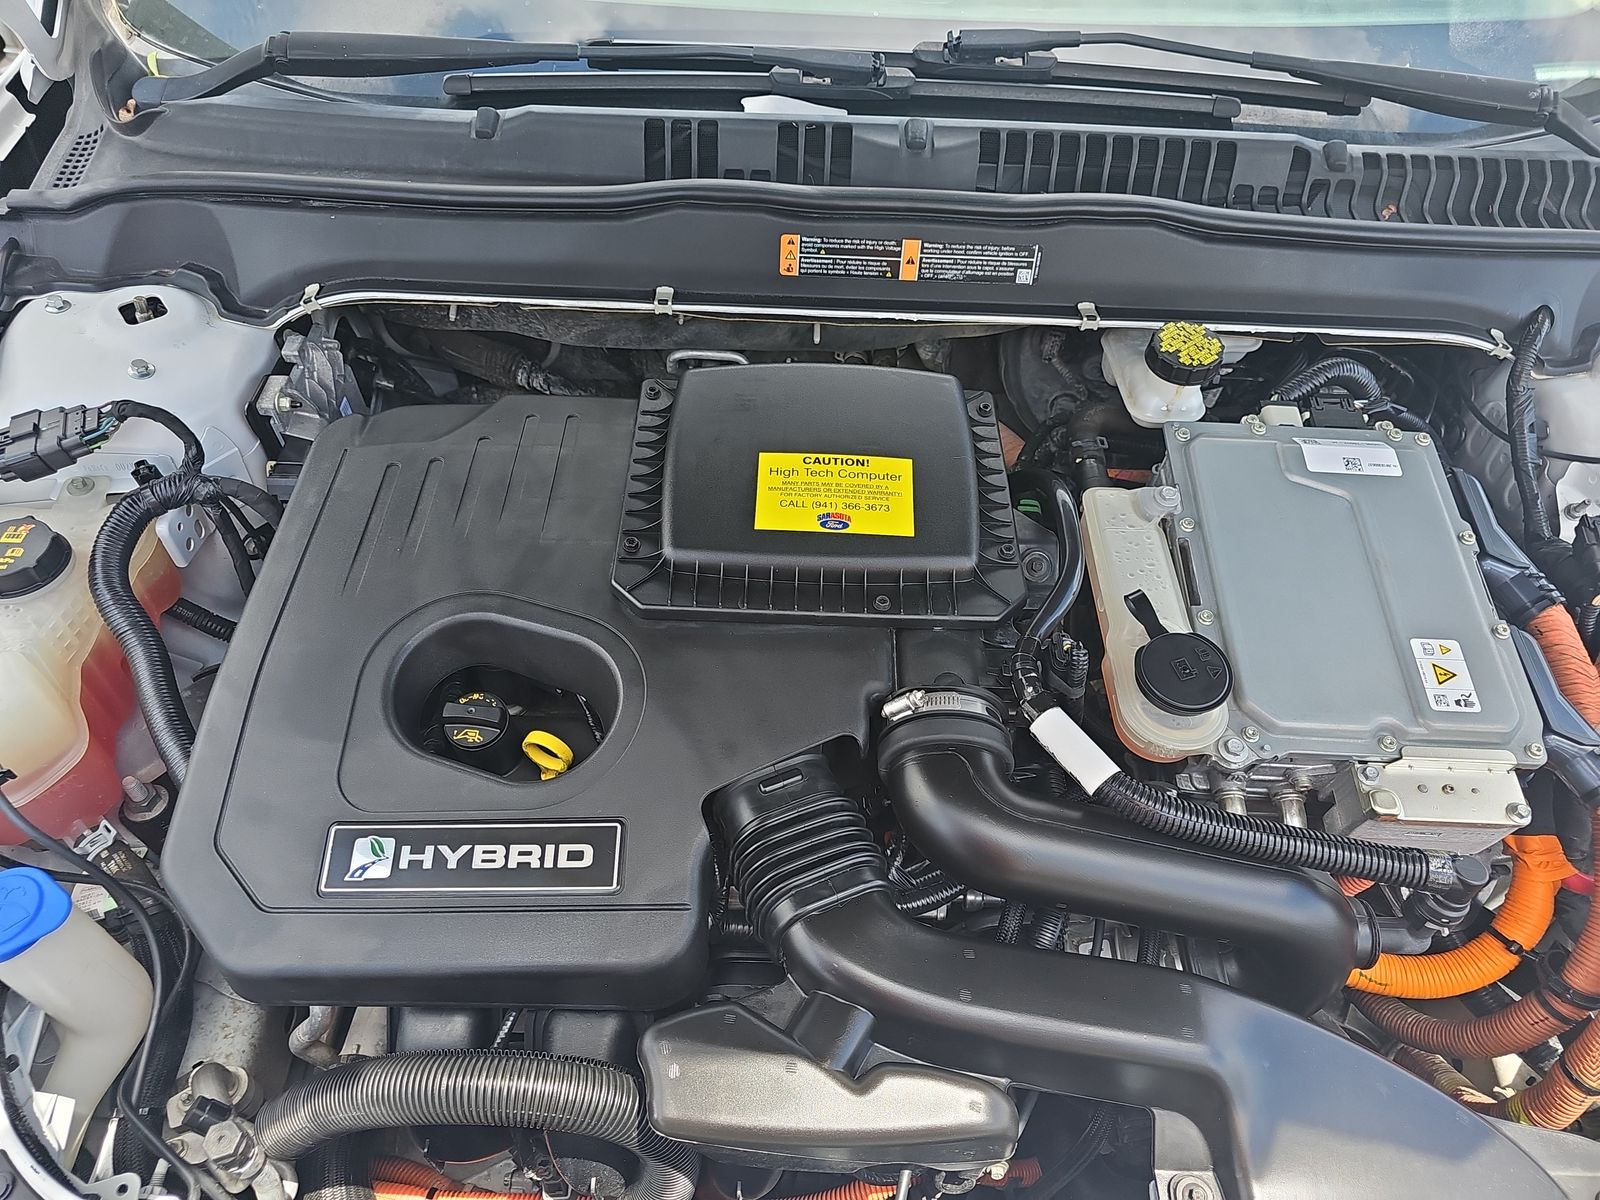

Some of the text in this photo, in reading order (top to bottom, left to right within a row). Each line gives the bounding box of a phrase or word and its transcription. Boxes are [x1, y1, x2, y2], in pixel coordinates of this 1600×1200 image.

[803, 456, 870, 467] CAUTION!
[770, 467, 902, 482] High Tech Computer
[780, 500, 890, 512] CALL (941) 366-3673
[817, 512, 852, 523] SARASOTA
[399, 844, 594, 870] HYBRID
